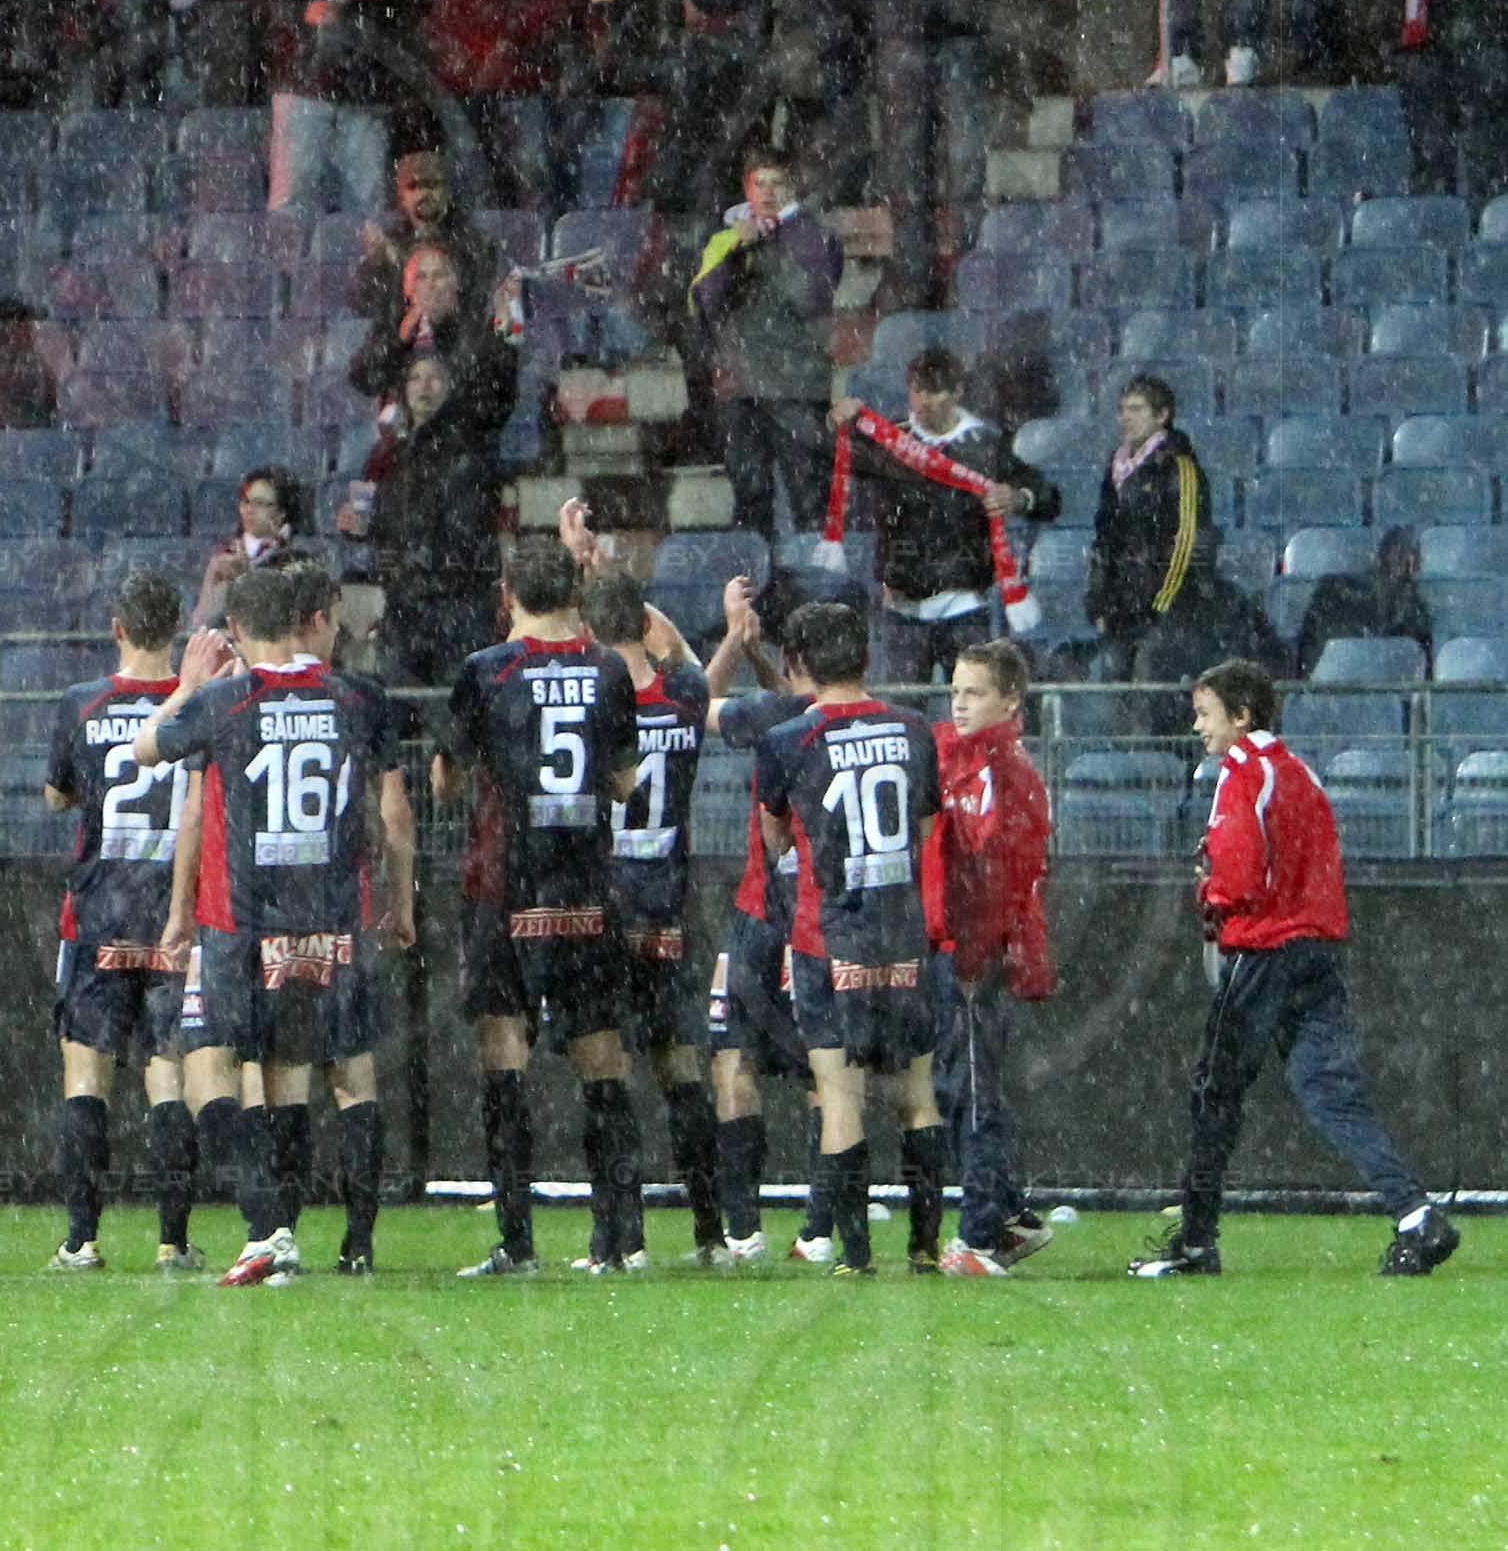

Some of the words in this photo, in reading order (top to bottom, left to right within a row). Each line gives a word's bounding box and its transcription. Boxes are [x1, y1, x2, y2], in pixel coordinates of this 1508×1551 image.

[532, 678, 596, 705] SARE
[85, 717, 148, 746] RADA
[260, 712, 339, 741] SÄUMEL
[539, 706, 586, 794] 5
[828, 737, 909, 769] RAUTER
[245, 742, 333, 833] 16
[822, 764, 909, 857] 10
[510, 916, 605, 937] ZEITUNG
